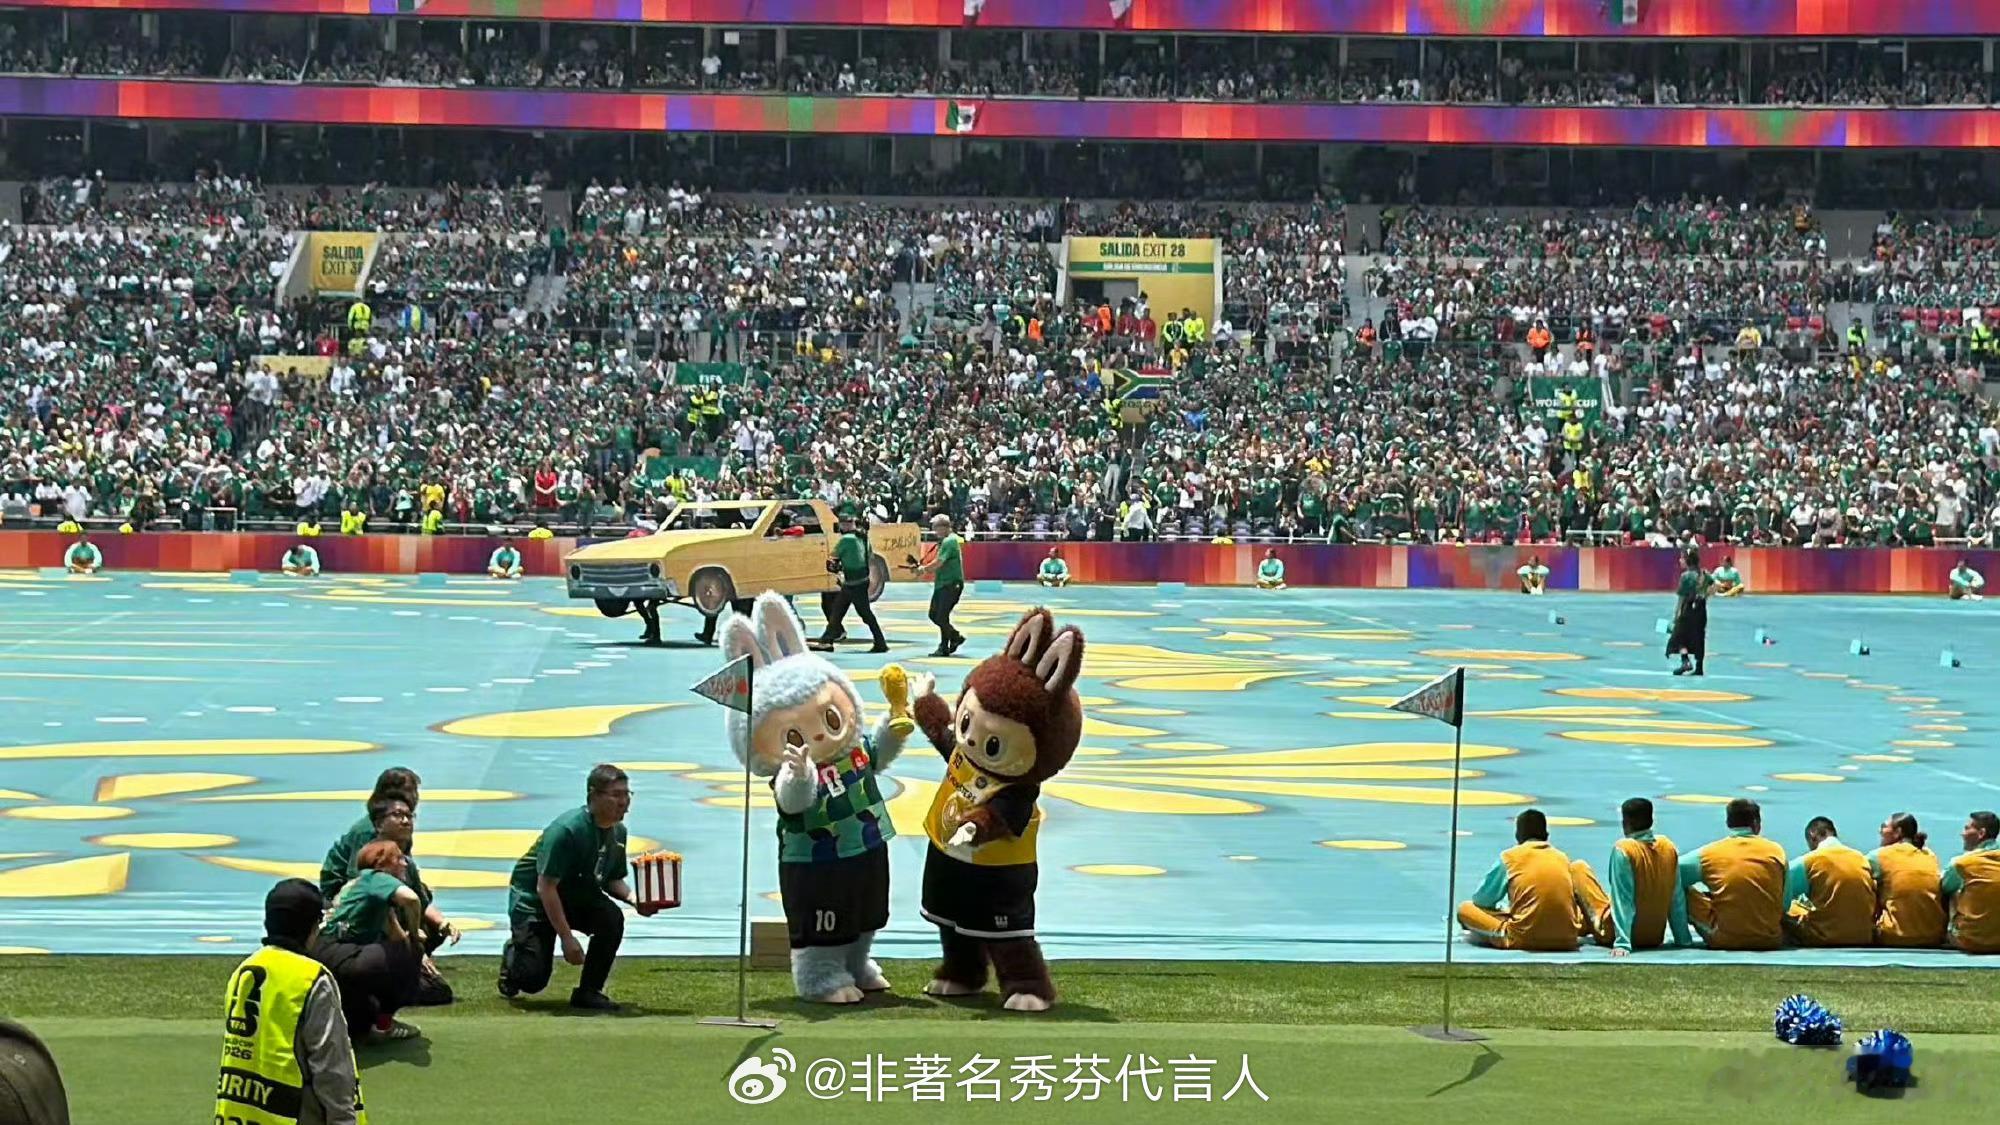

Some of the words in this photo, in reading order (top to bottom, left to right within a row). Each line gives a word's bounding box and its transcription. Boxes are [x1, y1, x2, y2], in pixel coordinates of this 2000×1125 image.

[323, 245, 363, 260] SALIDA
[1100, 242, 1139, 257] SALIDA
[1143, 243, 1167, 258] EXIT
[1170, 243, 1186, 258] 28
[322, 260, 346, 275] EXIT
[815, 909, 836, 932] 10
